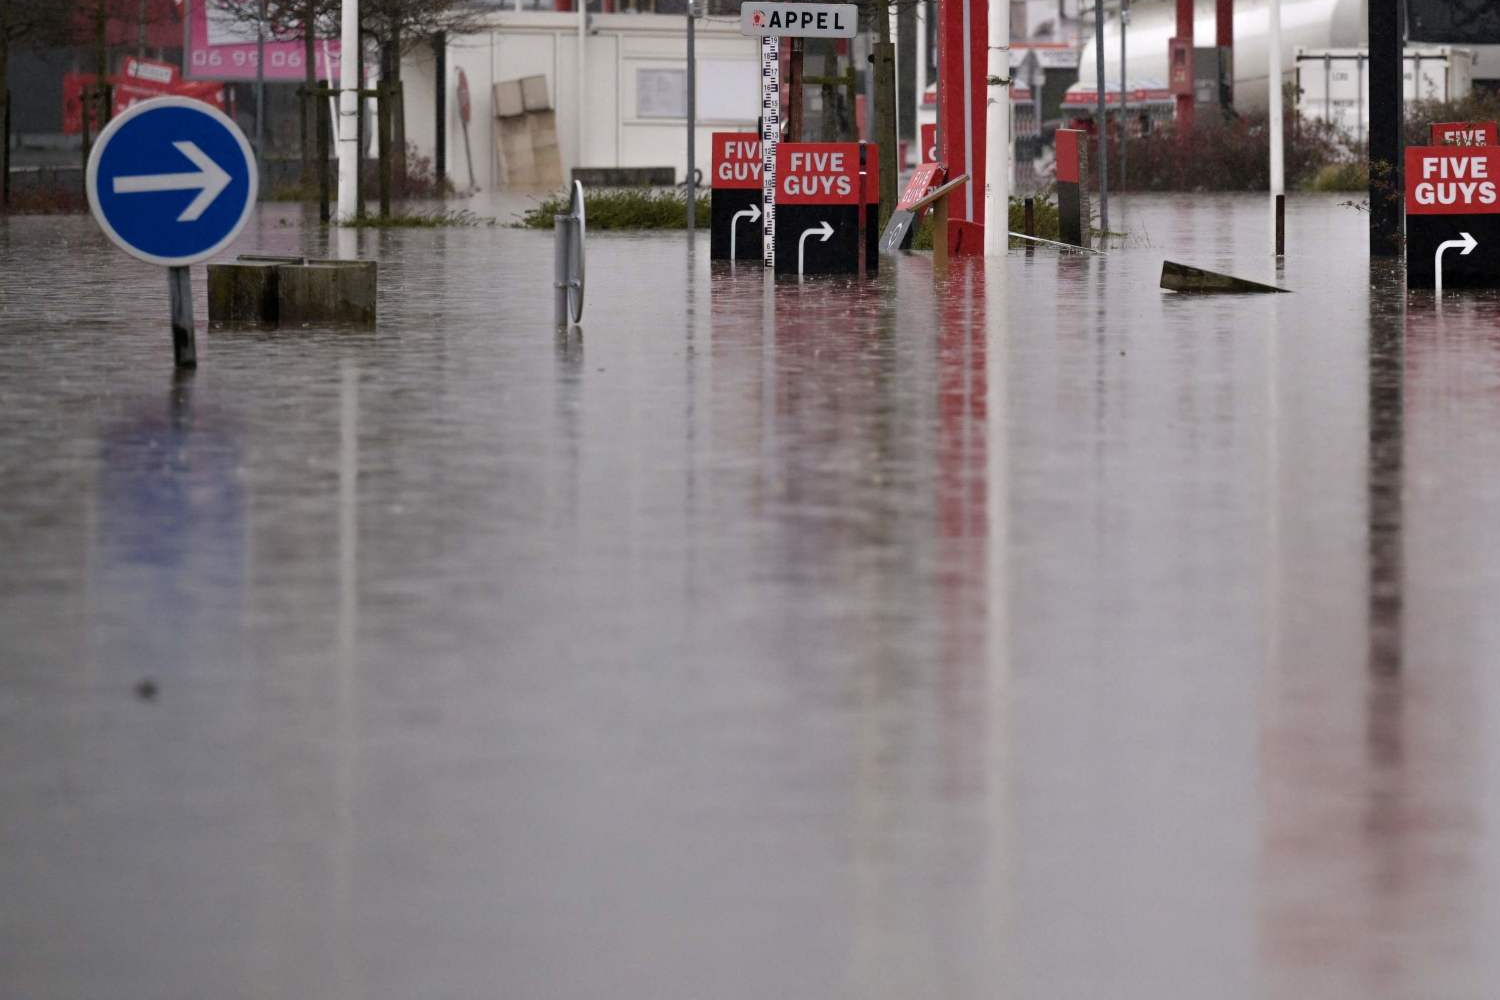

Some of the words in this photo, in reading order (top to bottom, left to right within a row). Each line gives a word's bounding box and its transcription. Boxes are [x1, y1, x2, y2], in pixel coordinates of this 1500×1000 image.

[753, 10, 844, 29] APPEL
[724, 141, 763, 159] FIV
[718, 162, 763, 181] GUY
[791, 152, 844, 172] FIVE
[1422, 156, 1488, 179] FIVE
[784, 175, 851, 196] GUYS
[1414, 181, 1497, 205] GUYS
